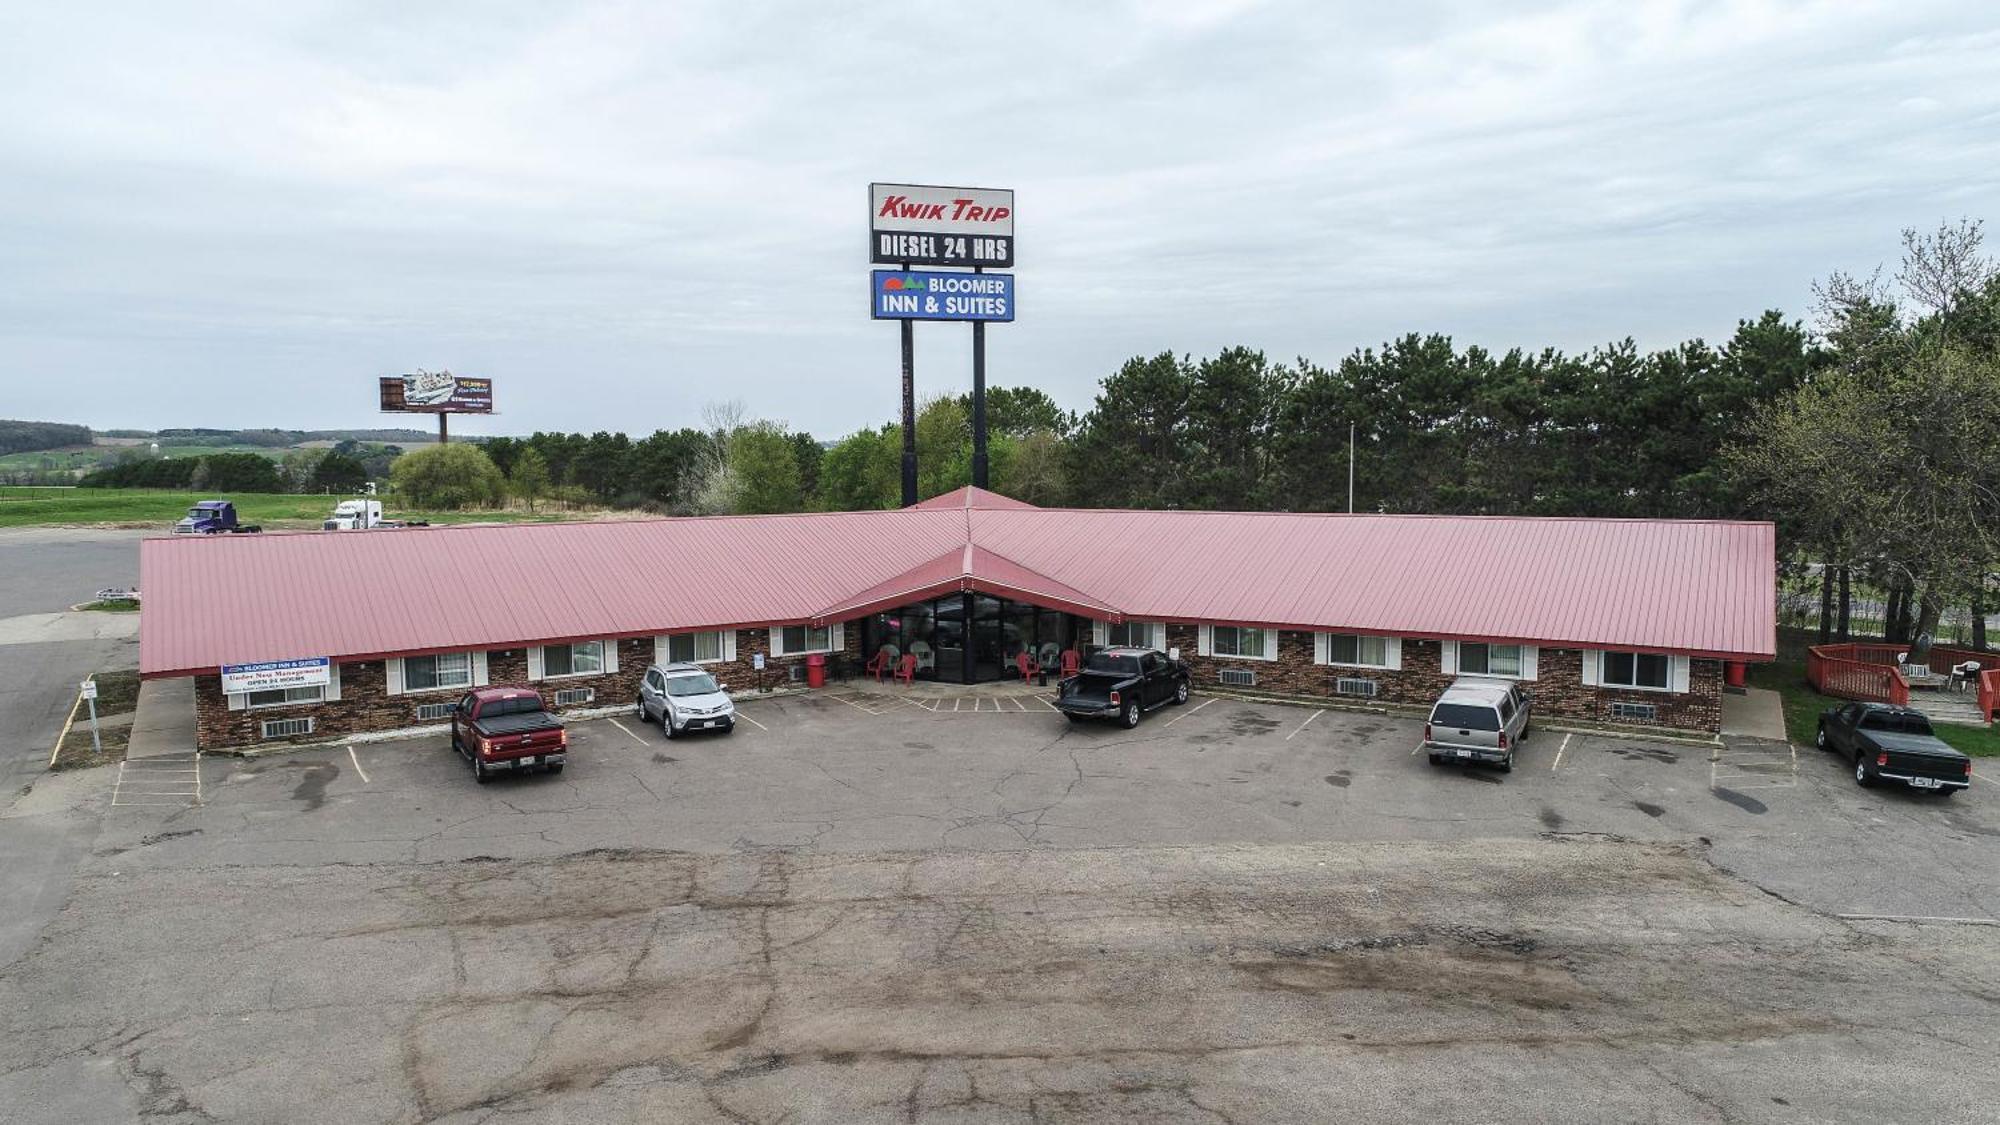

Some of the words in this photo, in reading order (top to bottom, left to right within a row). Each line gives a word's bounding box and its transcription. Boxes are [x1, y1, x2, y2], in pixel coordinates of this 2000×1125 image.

[880, 234, 937, 258] DIESEL
[944, 237, 966, 259] 24
[973, 238, 1007, 261] HRS
[929, 278, 1005, 295] BLOOMER
[882, 295, 918, 313] INN
[925, 296, 939, 314] &
[946, 297, 1006, 315] SUITES
[243, 663, 278, 672] BLOOMER
[278, 661, 290, 669] INN
[275, 668, 323, 677] Management
[279, 676, 305, 684] HOURS
